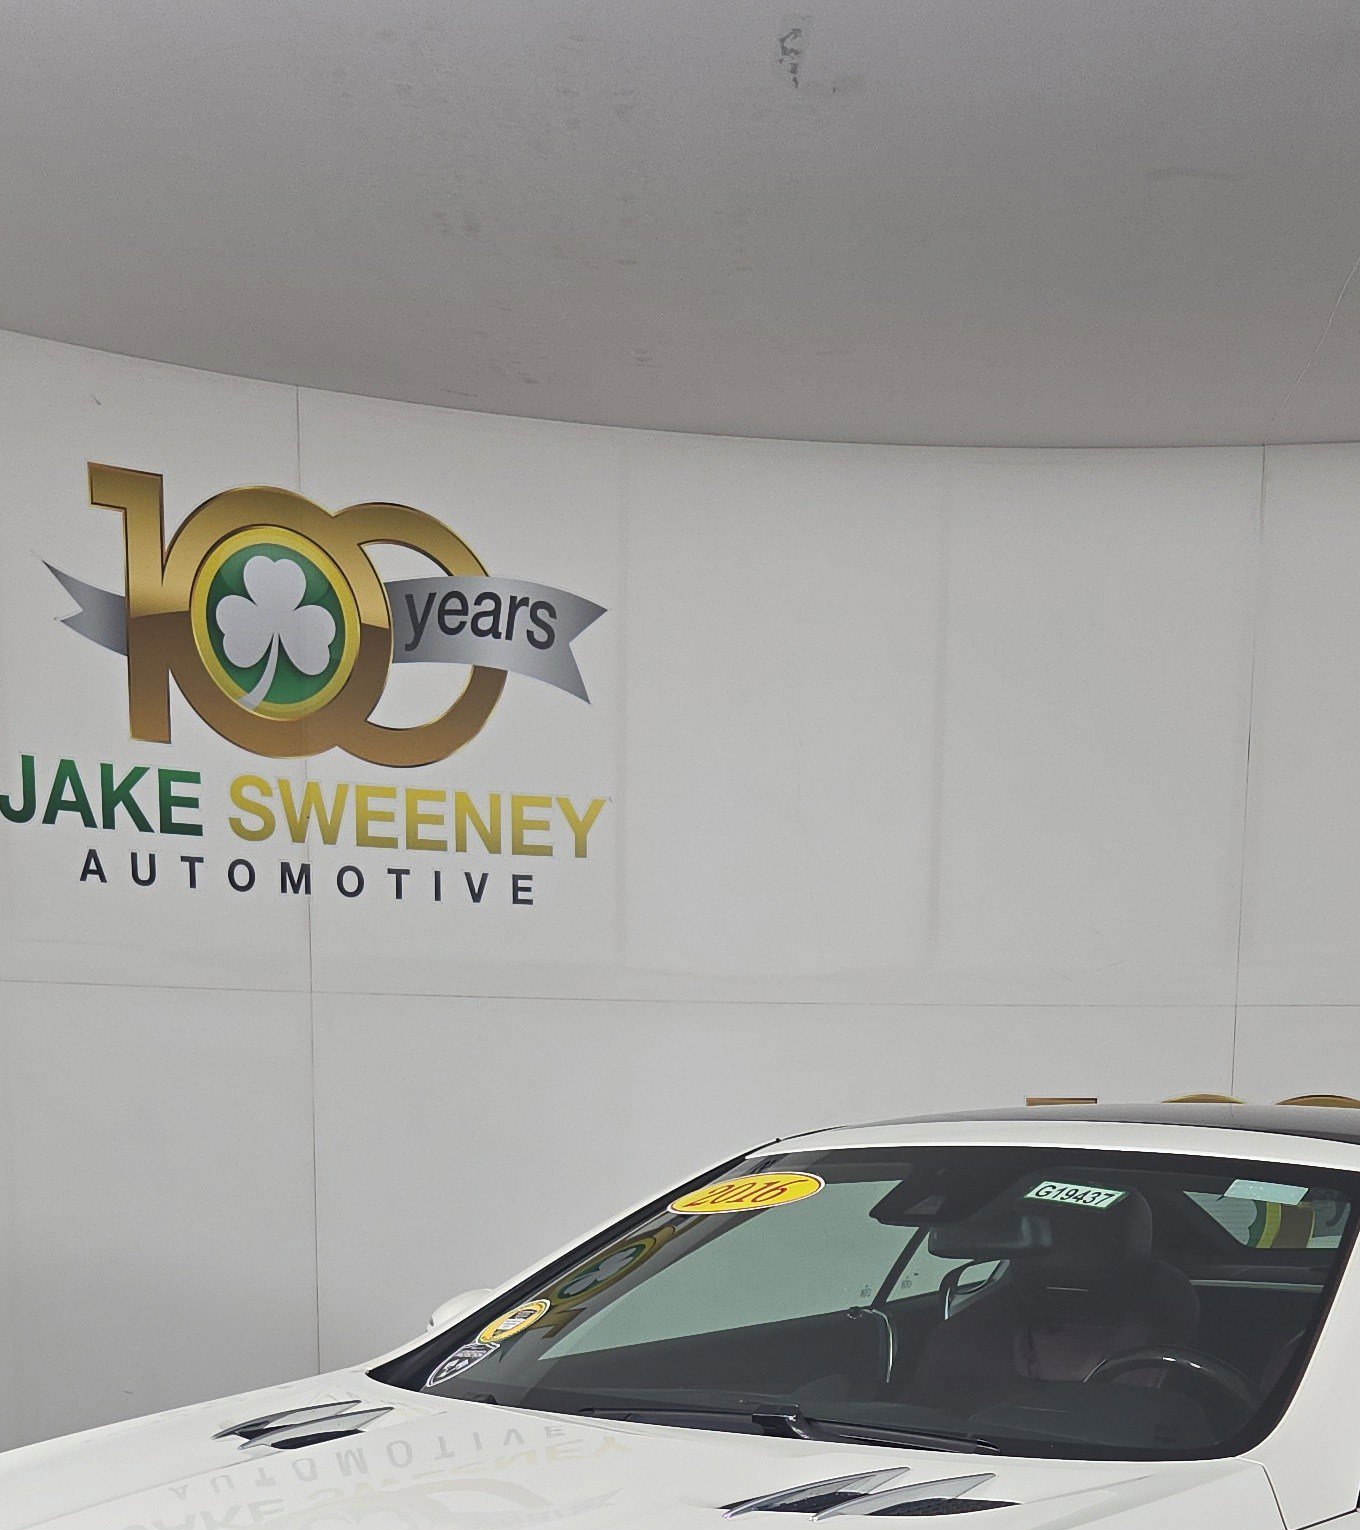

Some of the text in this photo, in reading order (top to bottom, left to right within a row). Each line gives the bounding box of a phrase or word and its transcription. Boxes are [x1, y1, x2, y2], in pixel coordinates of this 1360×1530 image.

[404, 590, 558, 652] years
[228, 775, 608, 859] SWEENEY
[80, 848, 535, 906] AUTOMOTIVE
[683, 1179, 808, 1208] 2016
[1035, 1185, 1115, 1207] G19437
